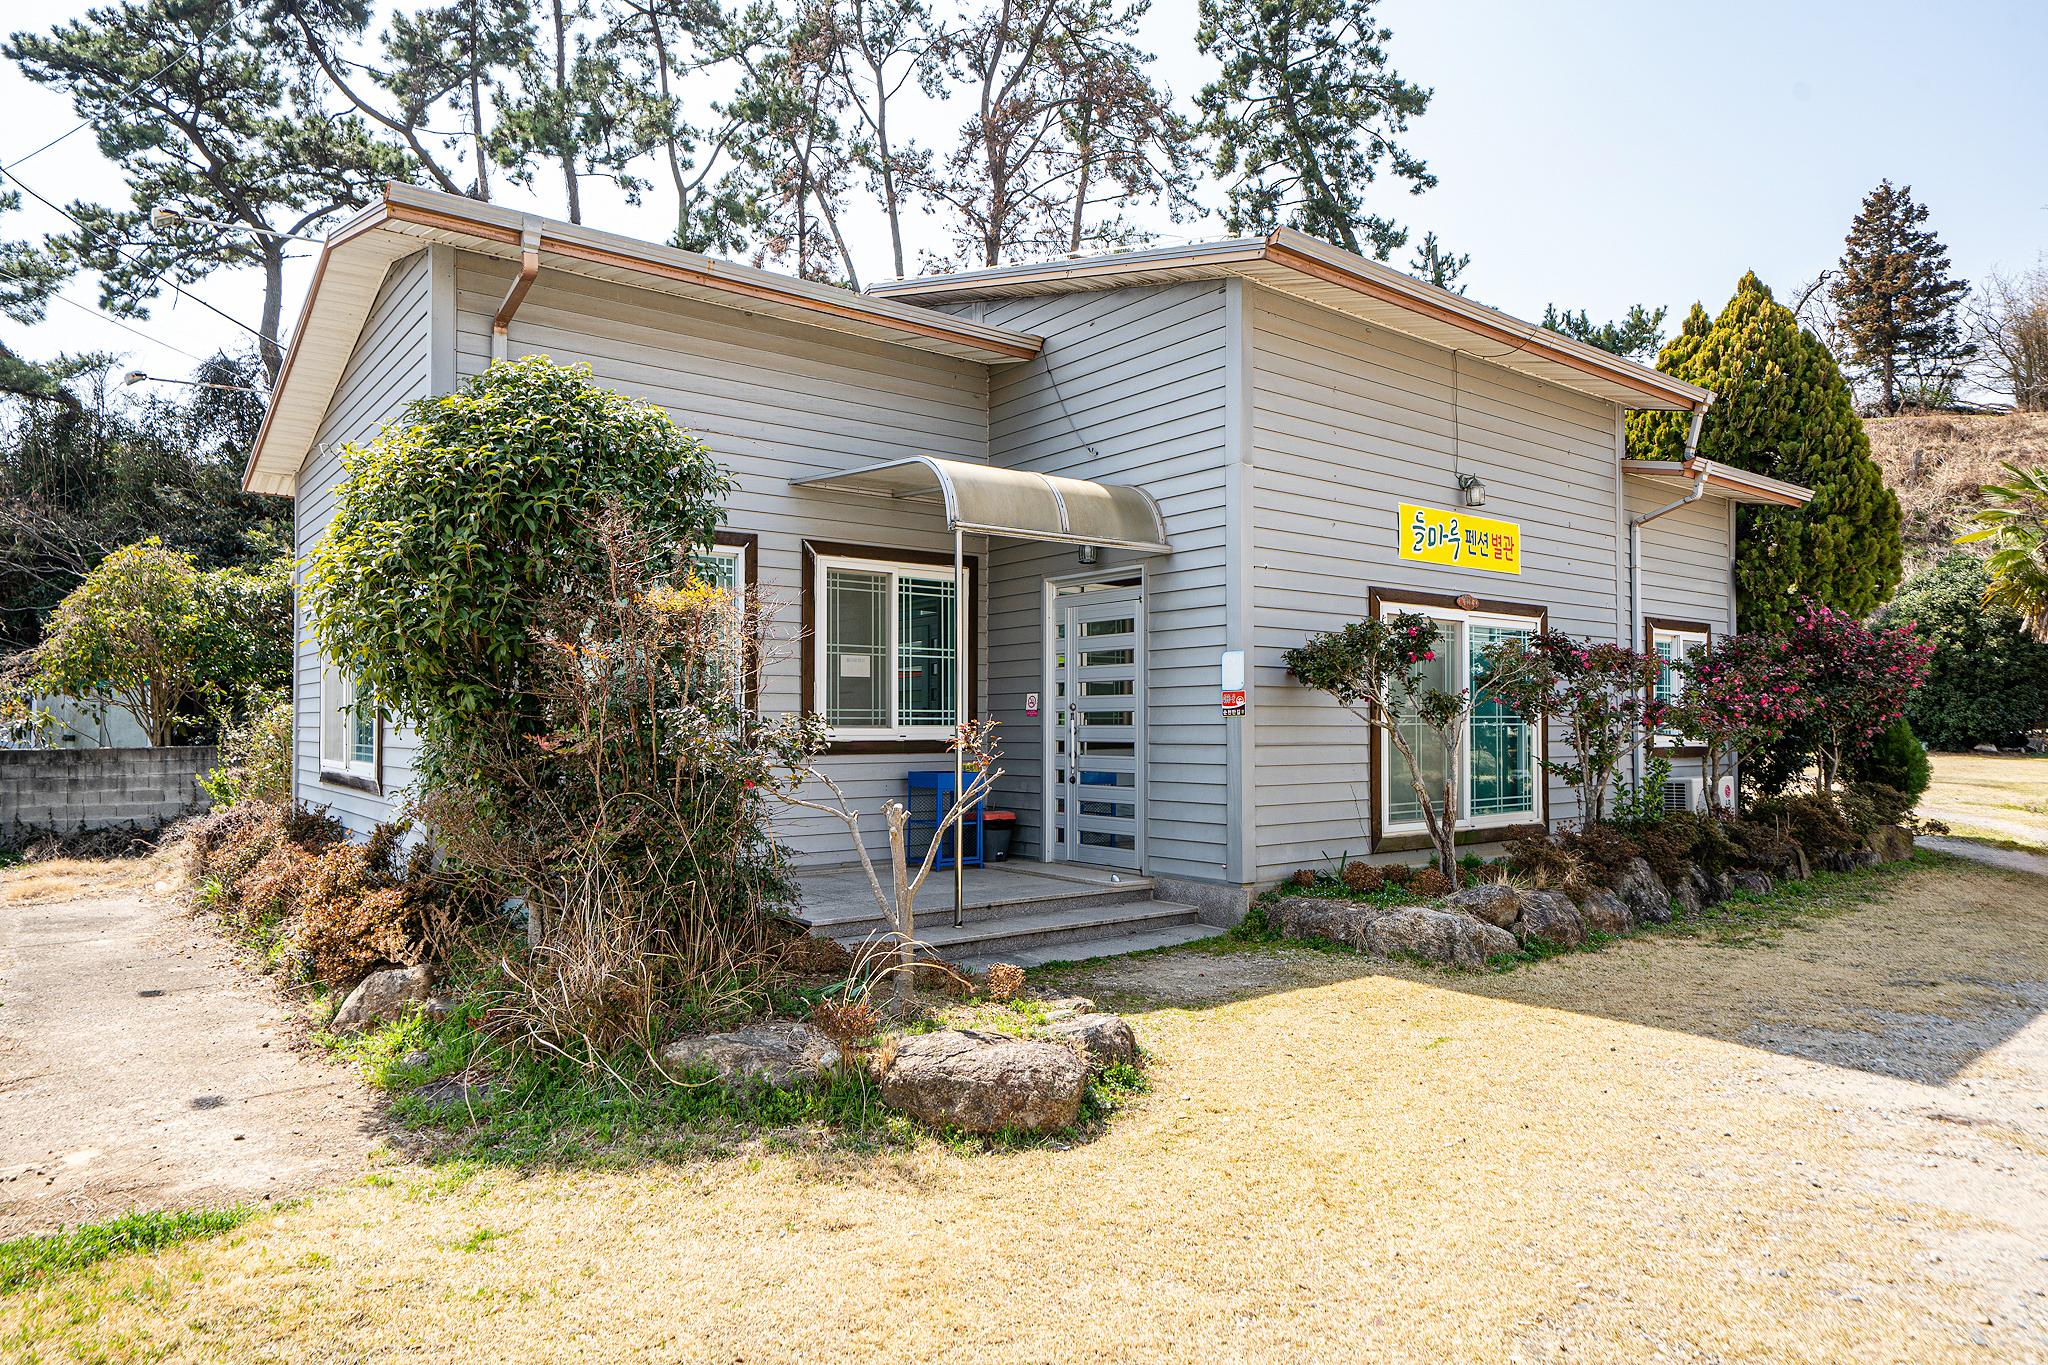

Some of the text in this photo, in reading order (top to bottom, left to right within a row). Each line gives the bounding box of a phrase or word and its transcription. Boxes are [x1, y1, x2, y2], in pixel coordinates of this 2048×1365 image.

[1412, 511, 1515, 561] 들마루 펜션 별관
